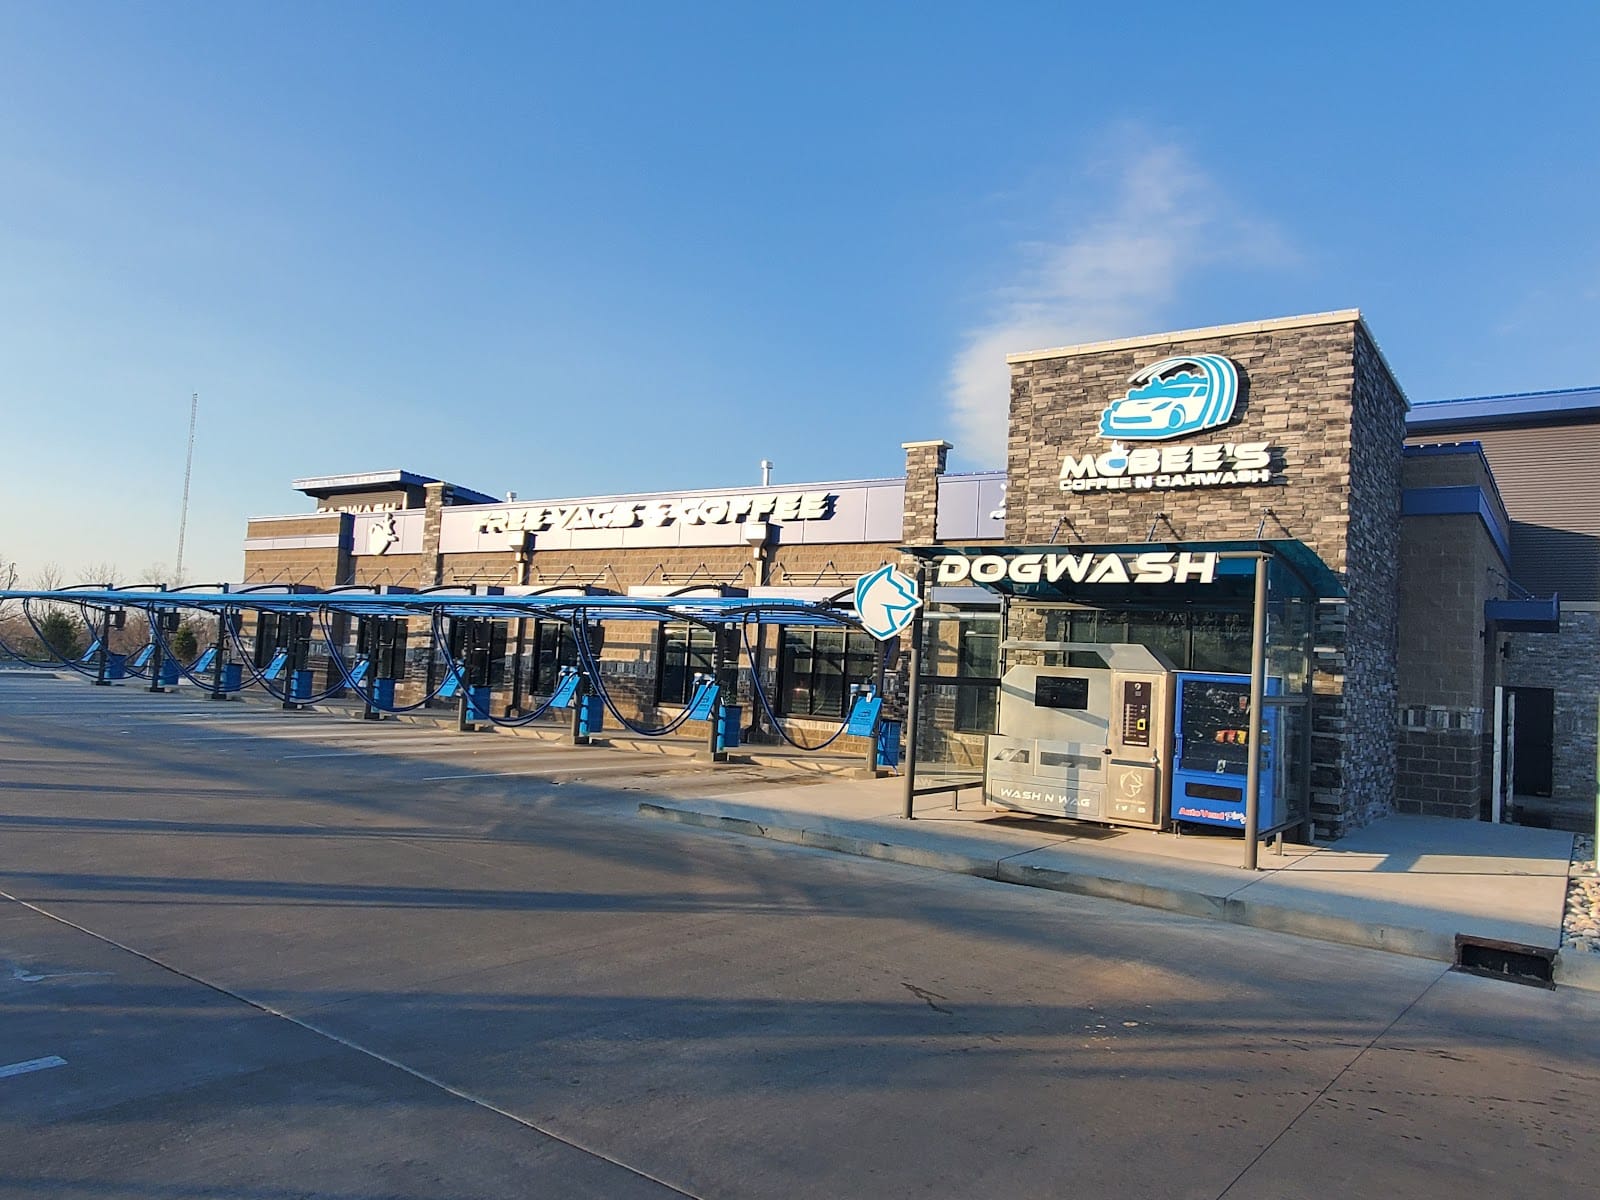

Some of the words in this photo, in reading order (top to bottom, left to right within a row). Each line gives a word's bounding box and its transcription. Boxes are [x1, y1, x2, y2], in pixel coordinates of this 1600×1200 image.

[1060, 476, 1131, 491] COFFEE
[1134, 475, 1153, 489] N
[1154, 468, 1270, 487] CARWASH
[474, 507, 550, 533] FREE
[557, 502, 643, 530] VACS
[680, 492, 831, 525] COFFEE
[937, 552, 1217, 583] DOGWASH
[1000, 788, 1041, 801] WASH
[1045, 793, 1054, 802] N
[1058, 795, 1091, 807] WAG
